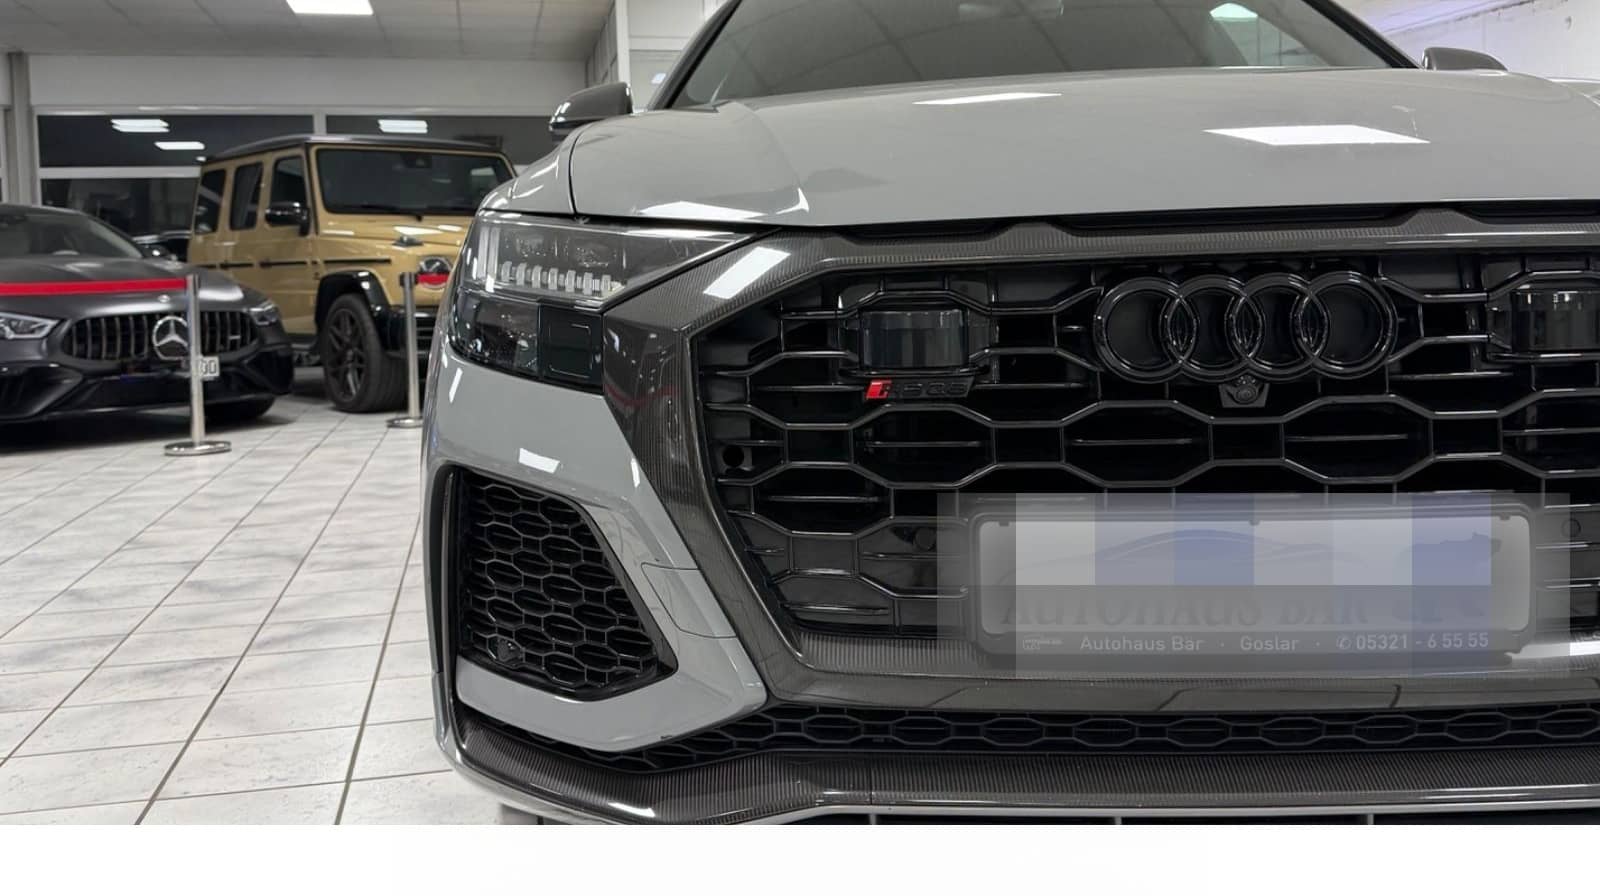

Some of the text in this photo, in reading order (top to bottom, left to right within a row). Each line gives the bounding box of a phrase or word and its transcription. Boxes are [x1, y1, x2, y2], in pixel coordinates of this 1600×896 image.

[1080, 635, 1166, 651] Autohaus
[1240, 635, 1299, 651] Goslar
[1356, 635, 1408, 650] 05321
